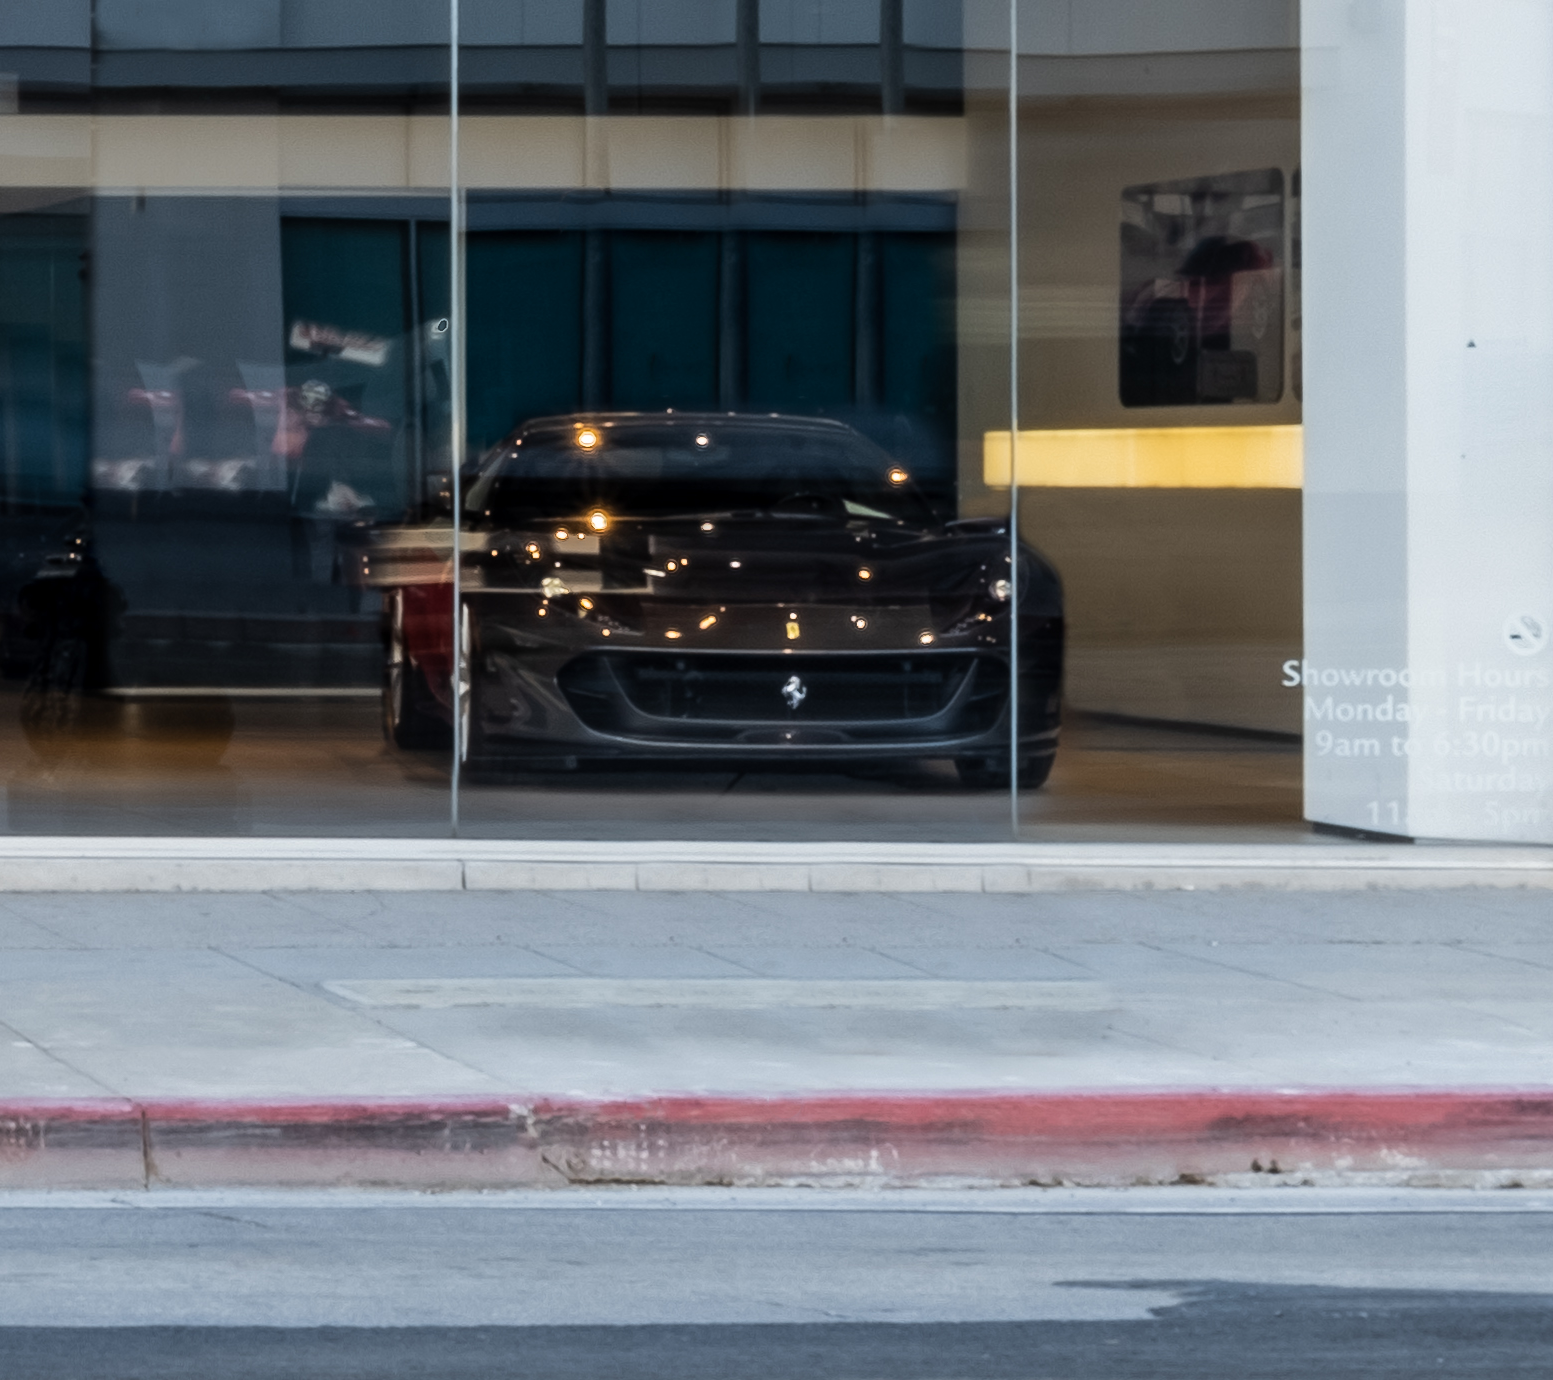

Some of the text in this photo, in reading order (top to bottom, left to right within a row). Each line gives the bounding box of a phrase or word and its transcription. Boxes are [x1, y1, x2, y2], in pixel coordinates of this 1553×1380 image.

[1281, 659, 1550, 688] Showroom Hours
[1304, 695, 1429, 729] Monday
[1458, 696, 1551, 730] Friday
[1314, 729, 1381, 757] 9am
[1391, 734, 1424, 758] to
